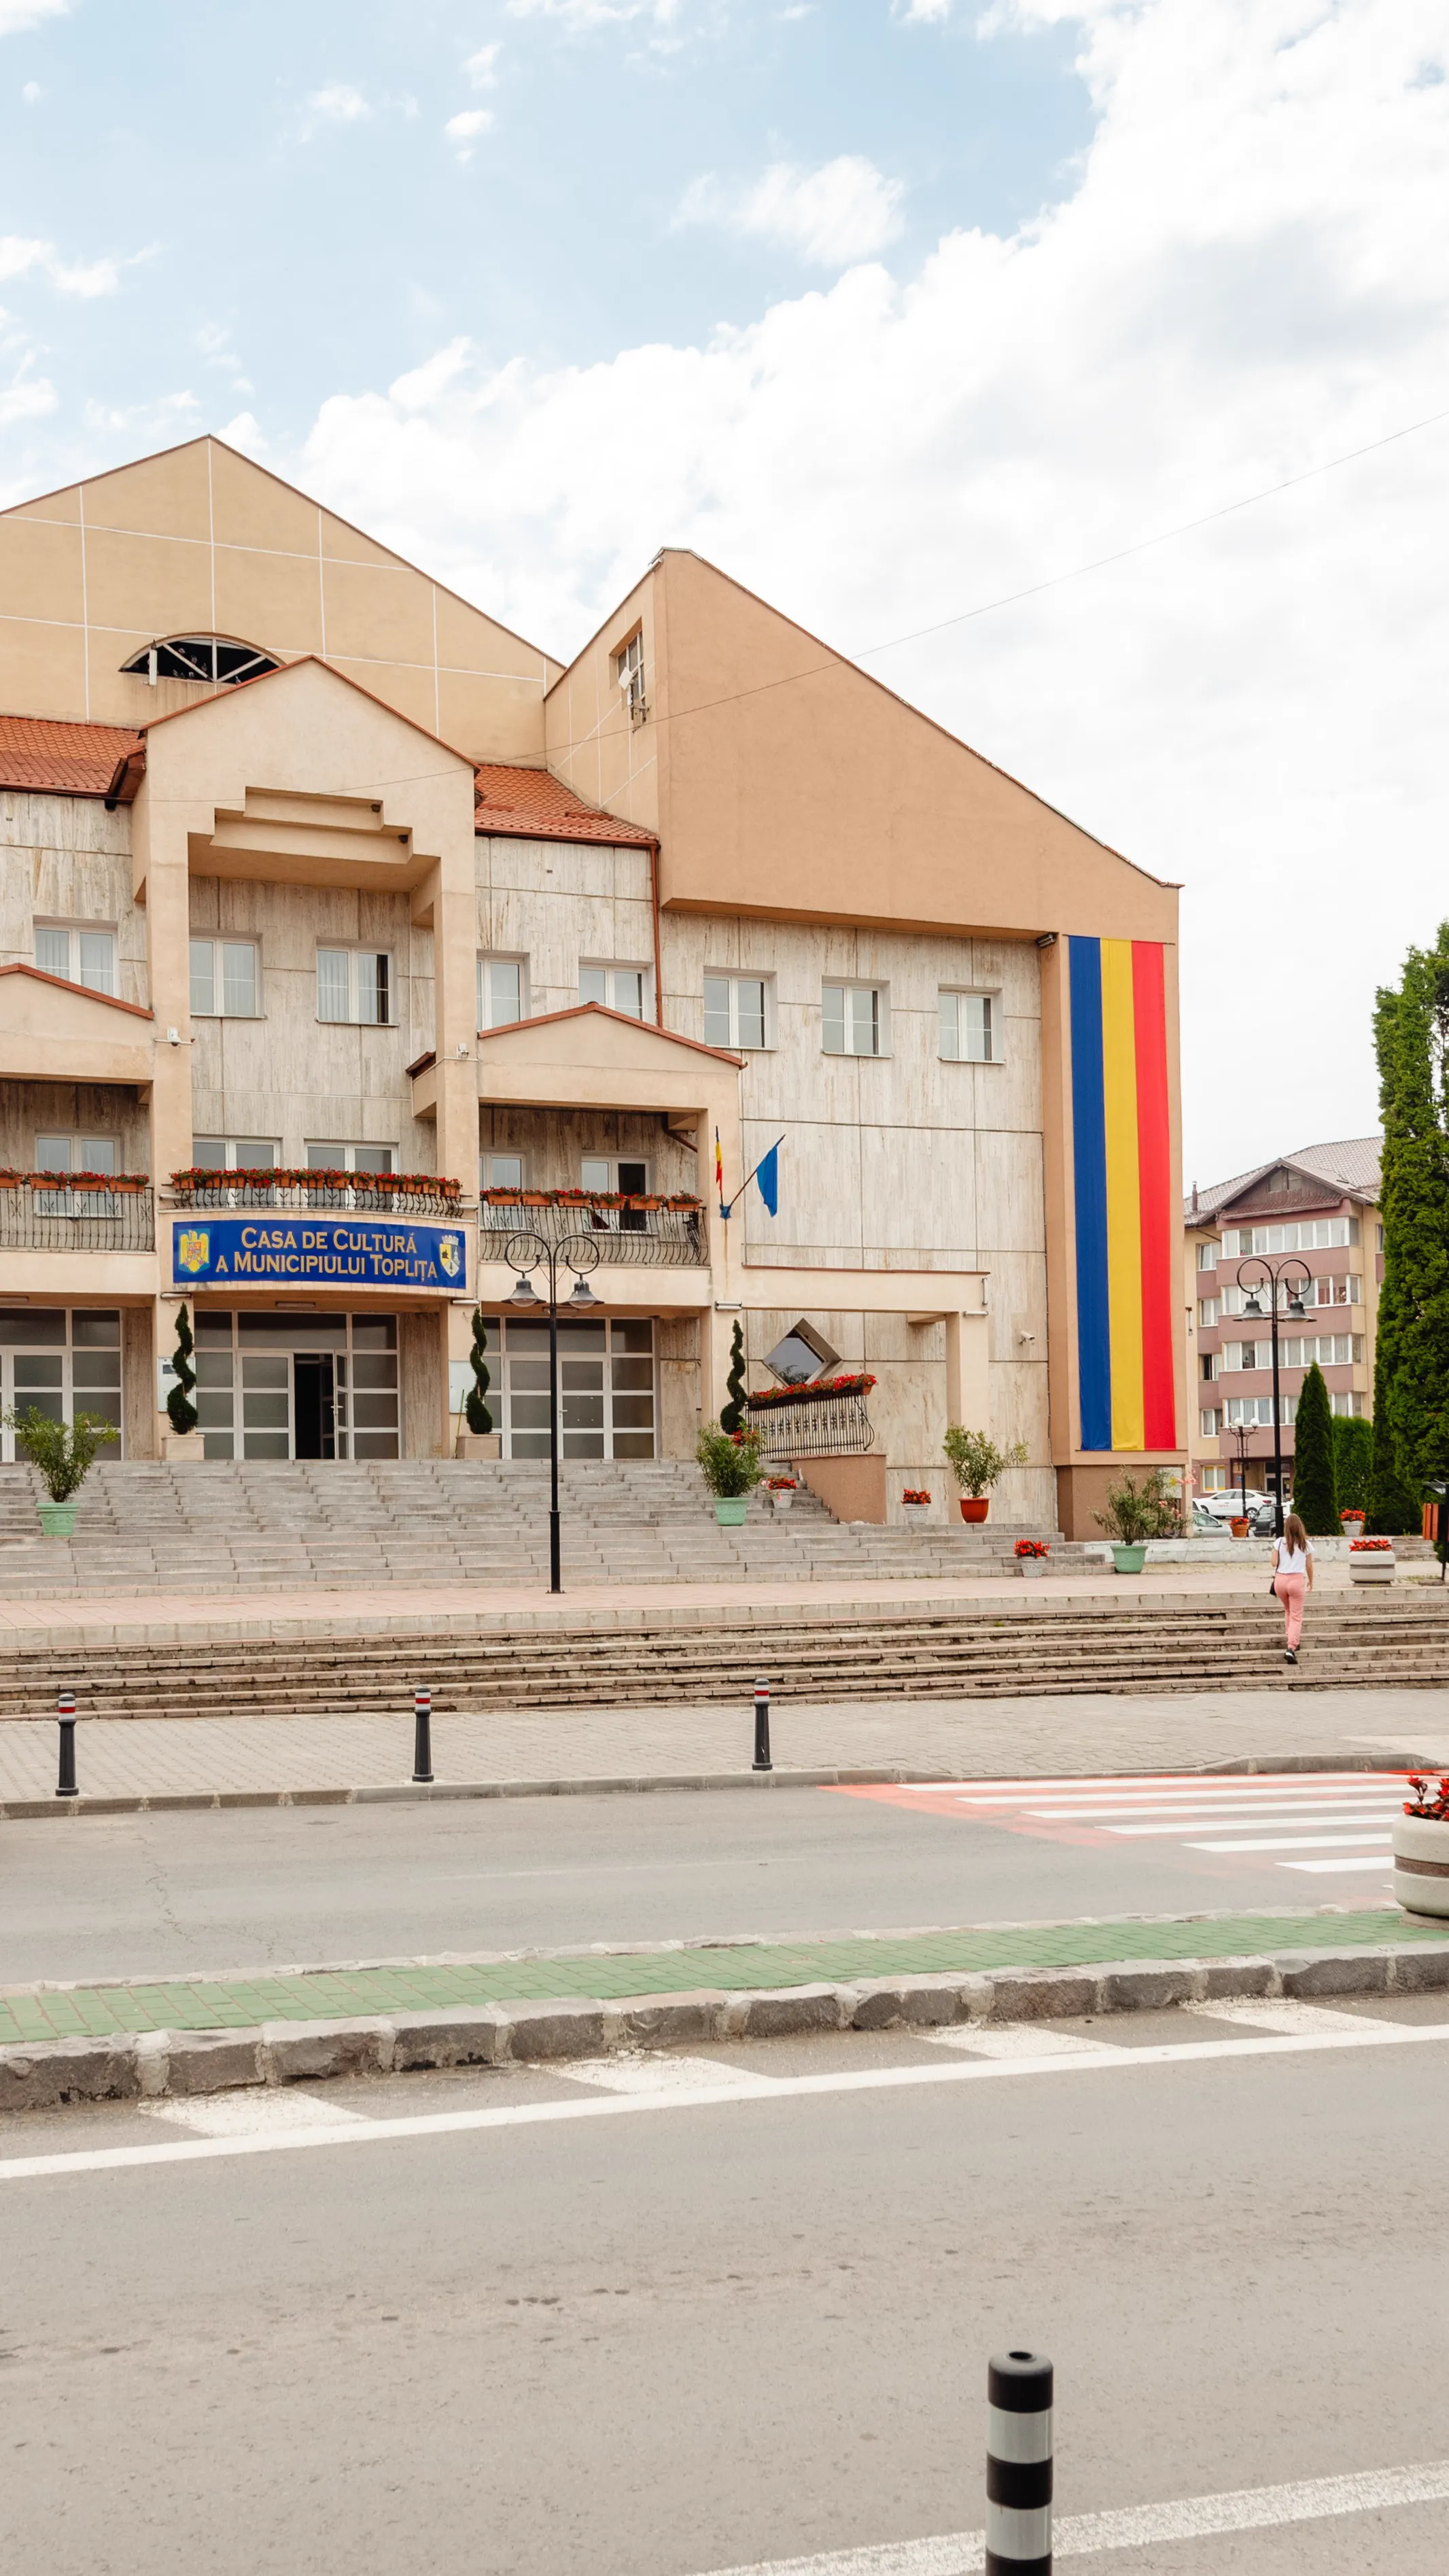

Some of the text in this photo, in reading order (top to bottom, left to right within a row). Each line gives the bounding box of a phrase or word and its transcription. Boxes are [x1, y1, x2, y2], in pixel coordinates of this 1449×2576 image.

[241, 1227, 417, 1253] CASA DE CULTURĂ
[215, 1255, 229, 1273] A
[234, 1251, 365, 1274] MUNICIPIULUI
